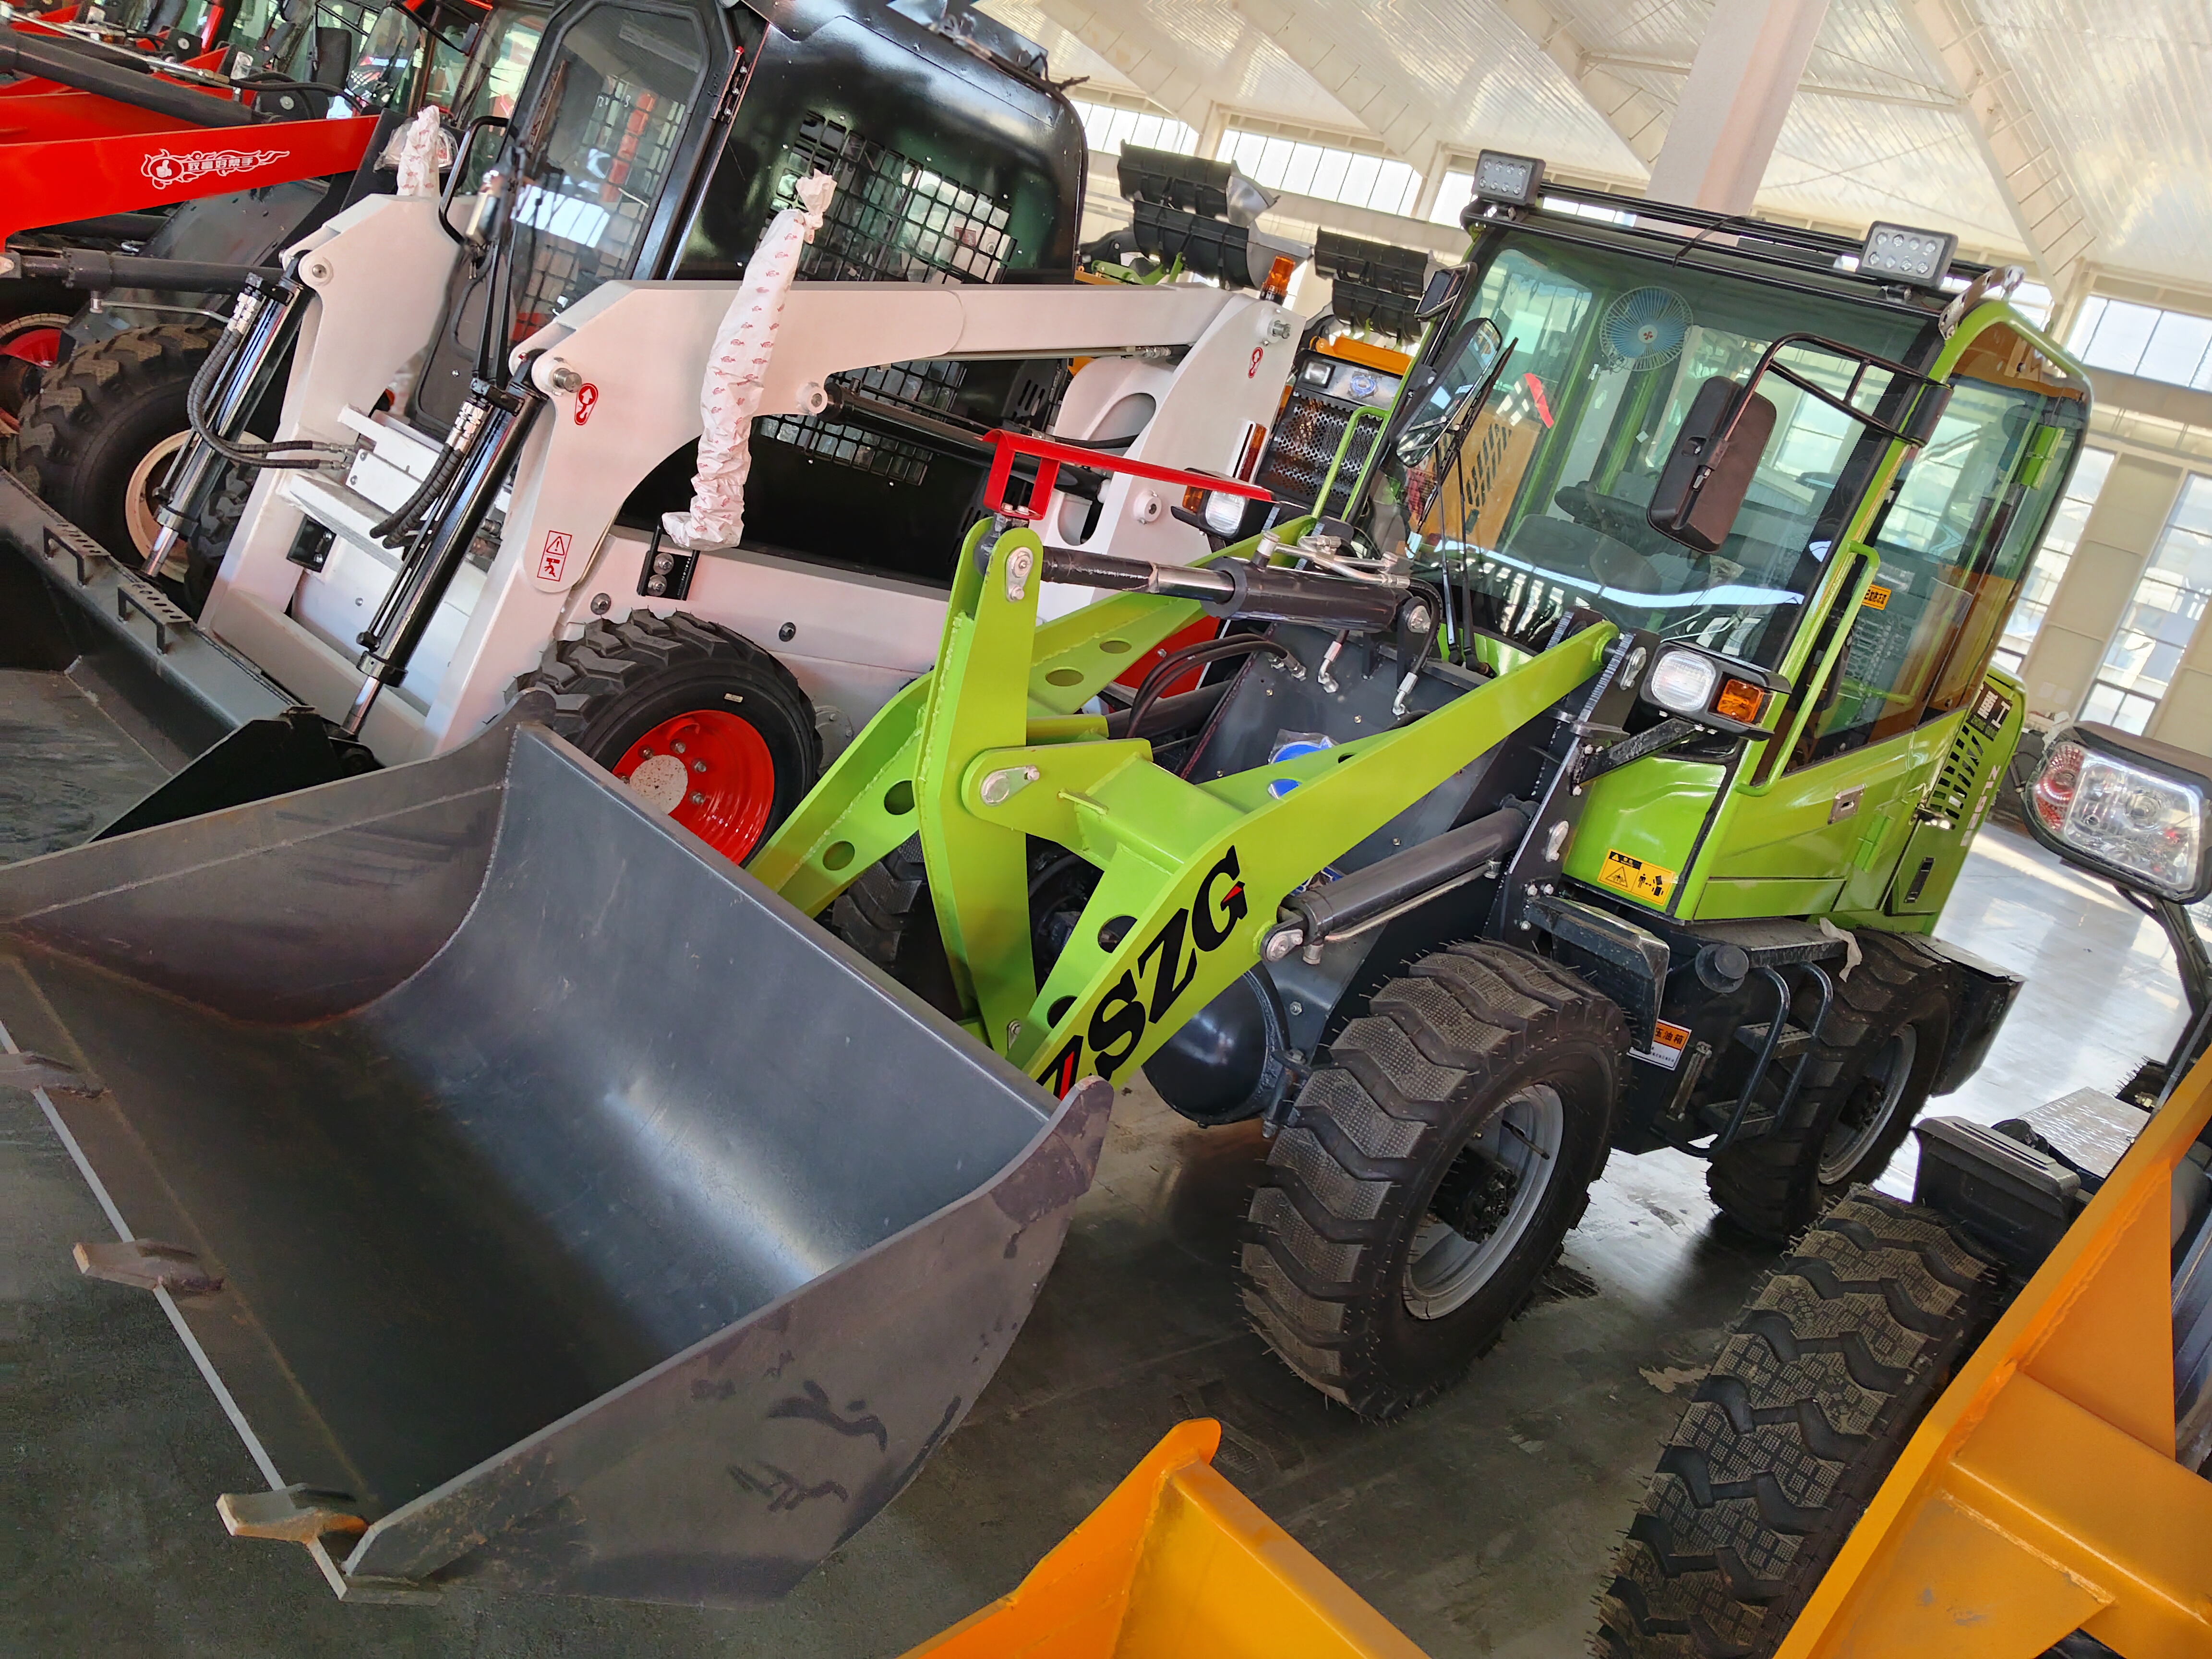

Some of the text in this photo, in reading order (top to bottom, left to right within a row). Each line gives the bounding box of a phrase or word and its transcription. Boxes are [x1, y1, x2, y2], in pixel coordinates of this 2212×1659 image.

[188, 157, 254, 172] 致富好帮手
